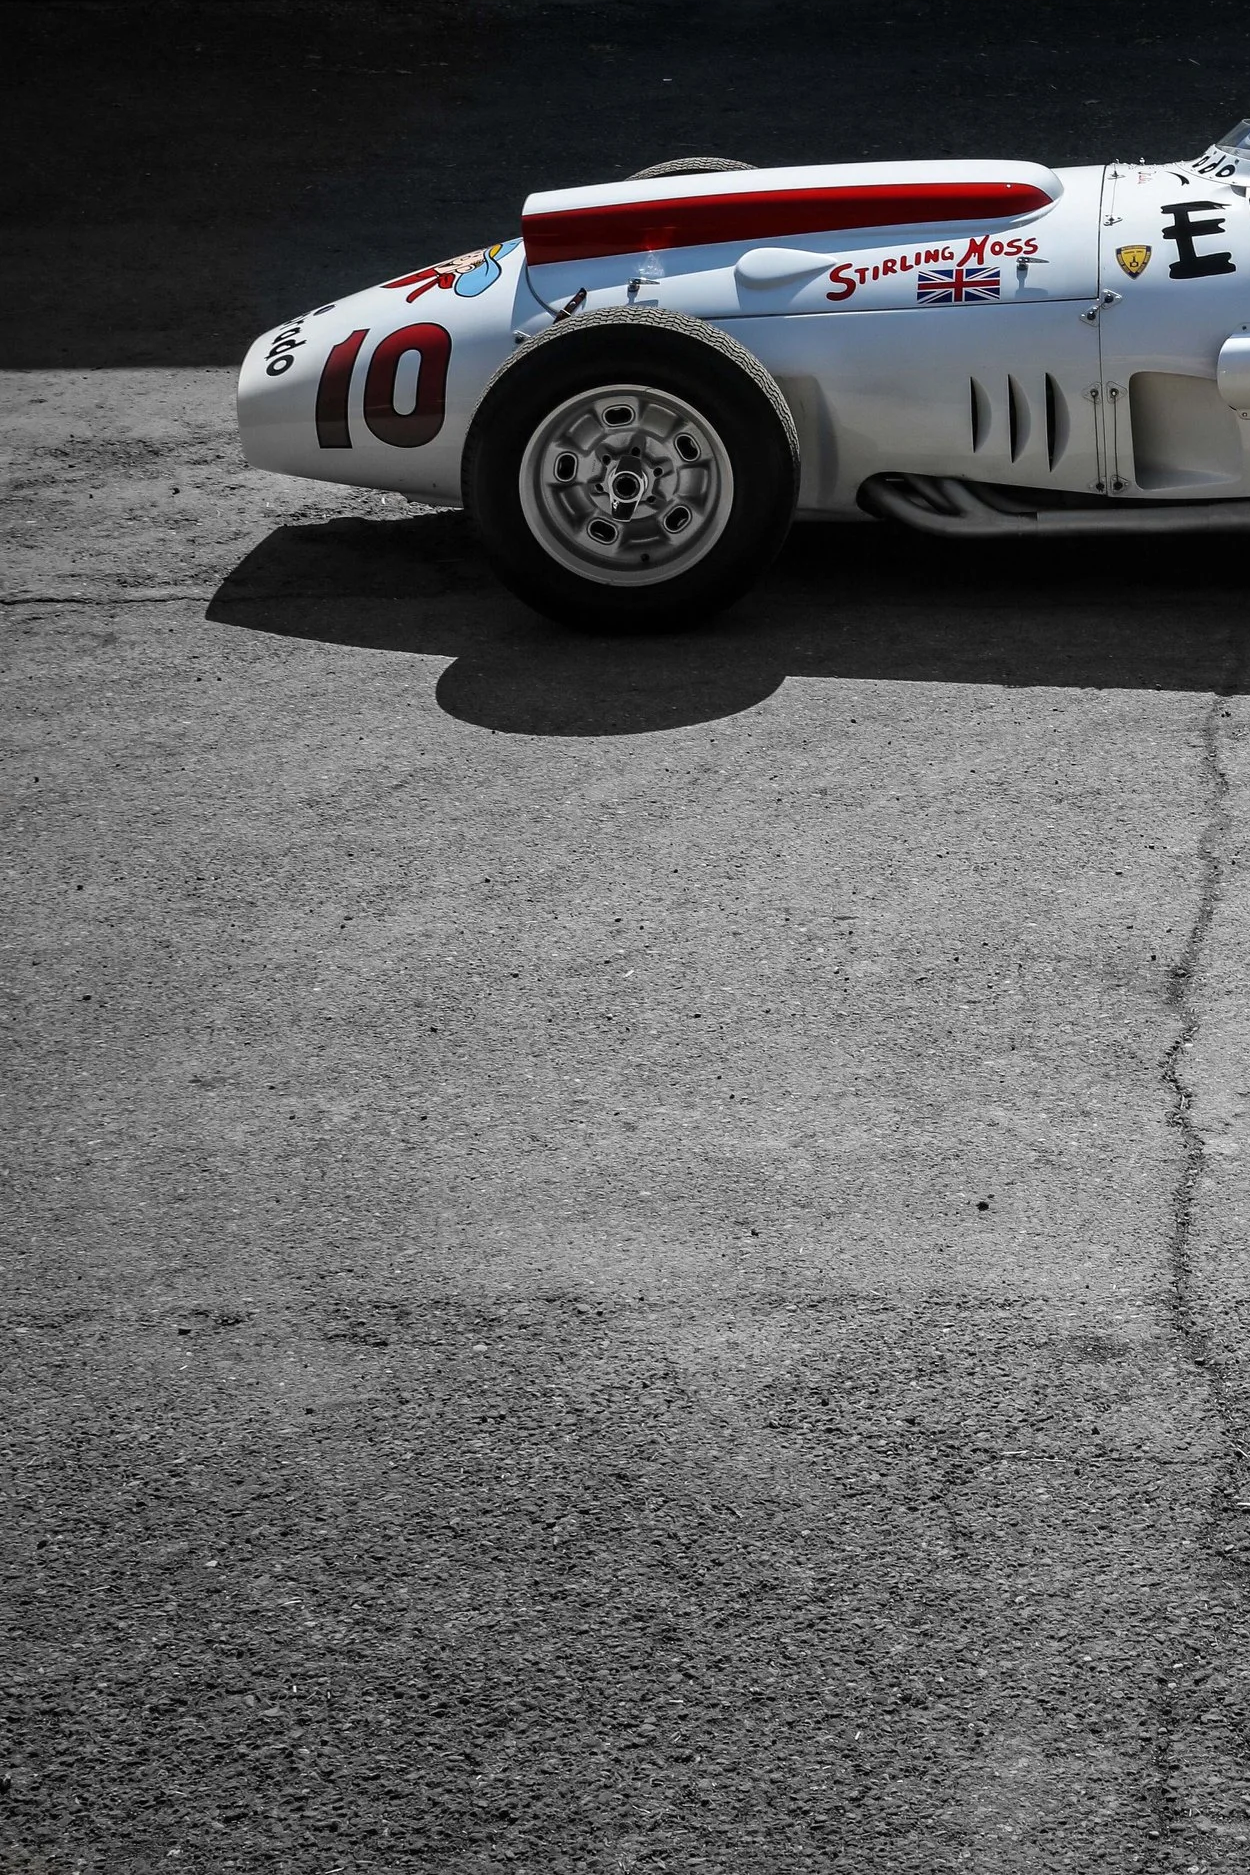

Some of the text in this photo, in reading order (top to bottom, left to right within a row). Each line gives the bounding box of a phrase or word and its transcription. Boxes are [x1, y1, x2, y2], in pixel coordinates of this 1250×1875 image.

[826, 234, 1039, 302] STIRLING MOSS
[315, 322, 452, 449] 10
